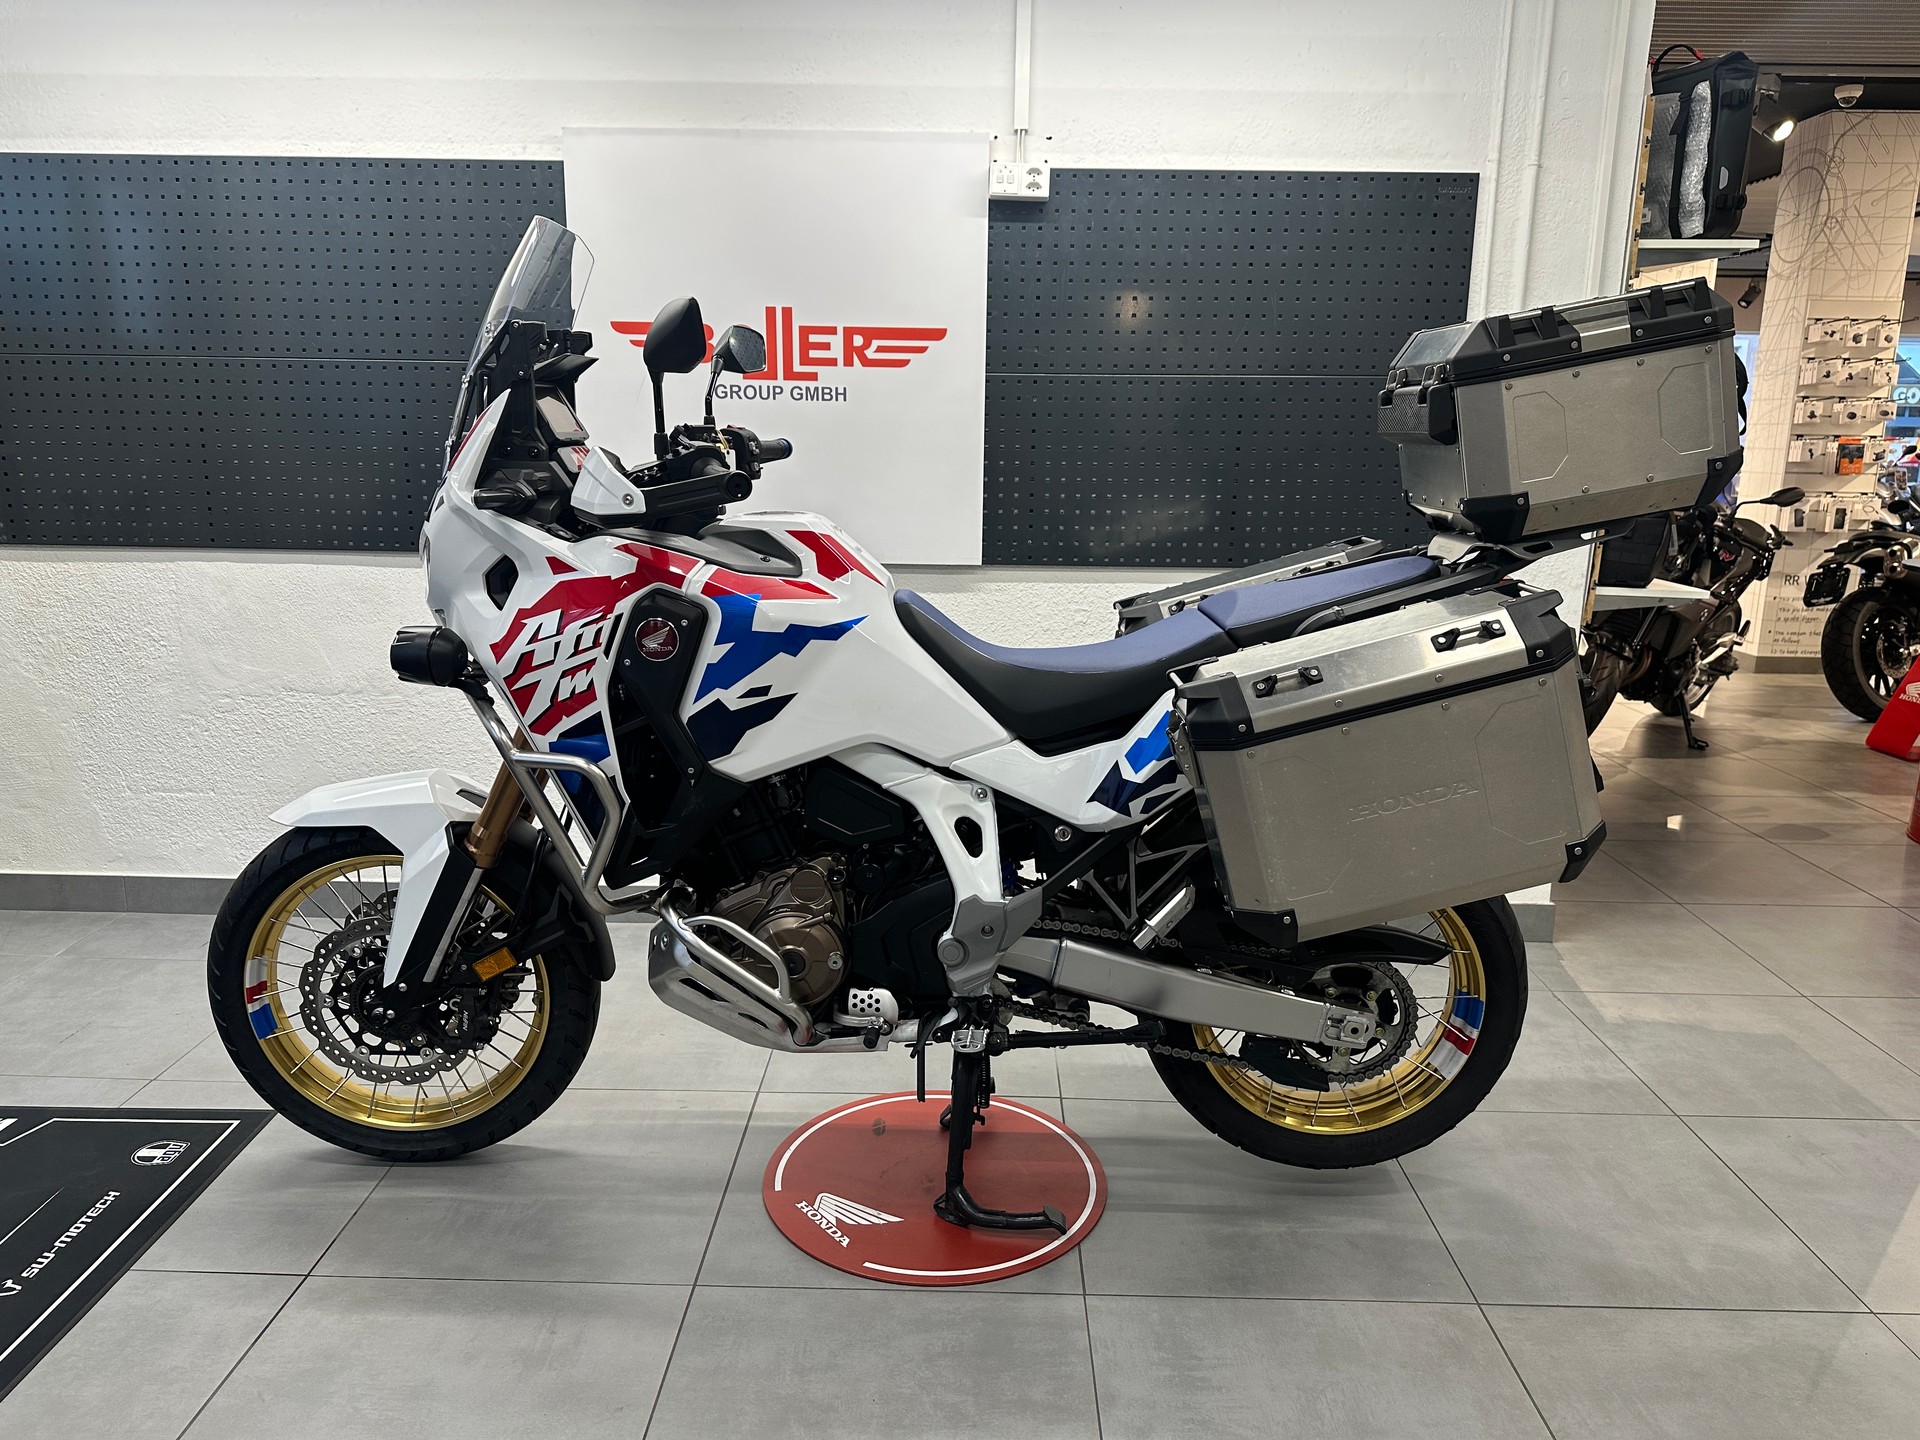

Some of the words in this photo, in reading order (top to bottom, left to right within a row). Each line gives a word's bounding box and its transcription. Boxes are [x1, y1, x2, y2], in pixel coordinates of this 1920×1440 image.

[714, 383, 784, 401] GROUP
[789, 385, 847, 402] GMBH
[642, 645, 674, 653] HONDA
[1347, 779, 1480, 822] HONDA
[795, 1200, 851, 1248] HONDA
